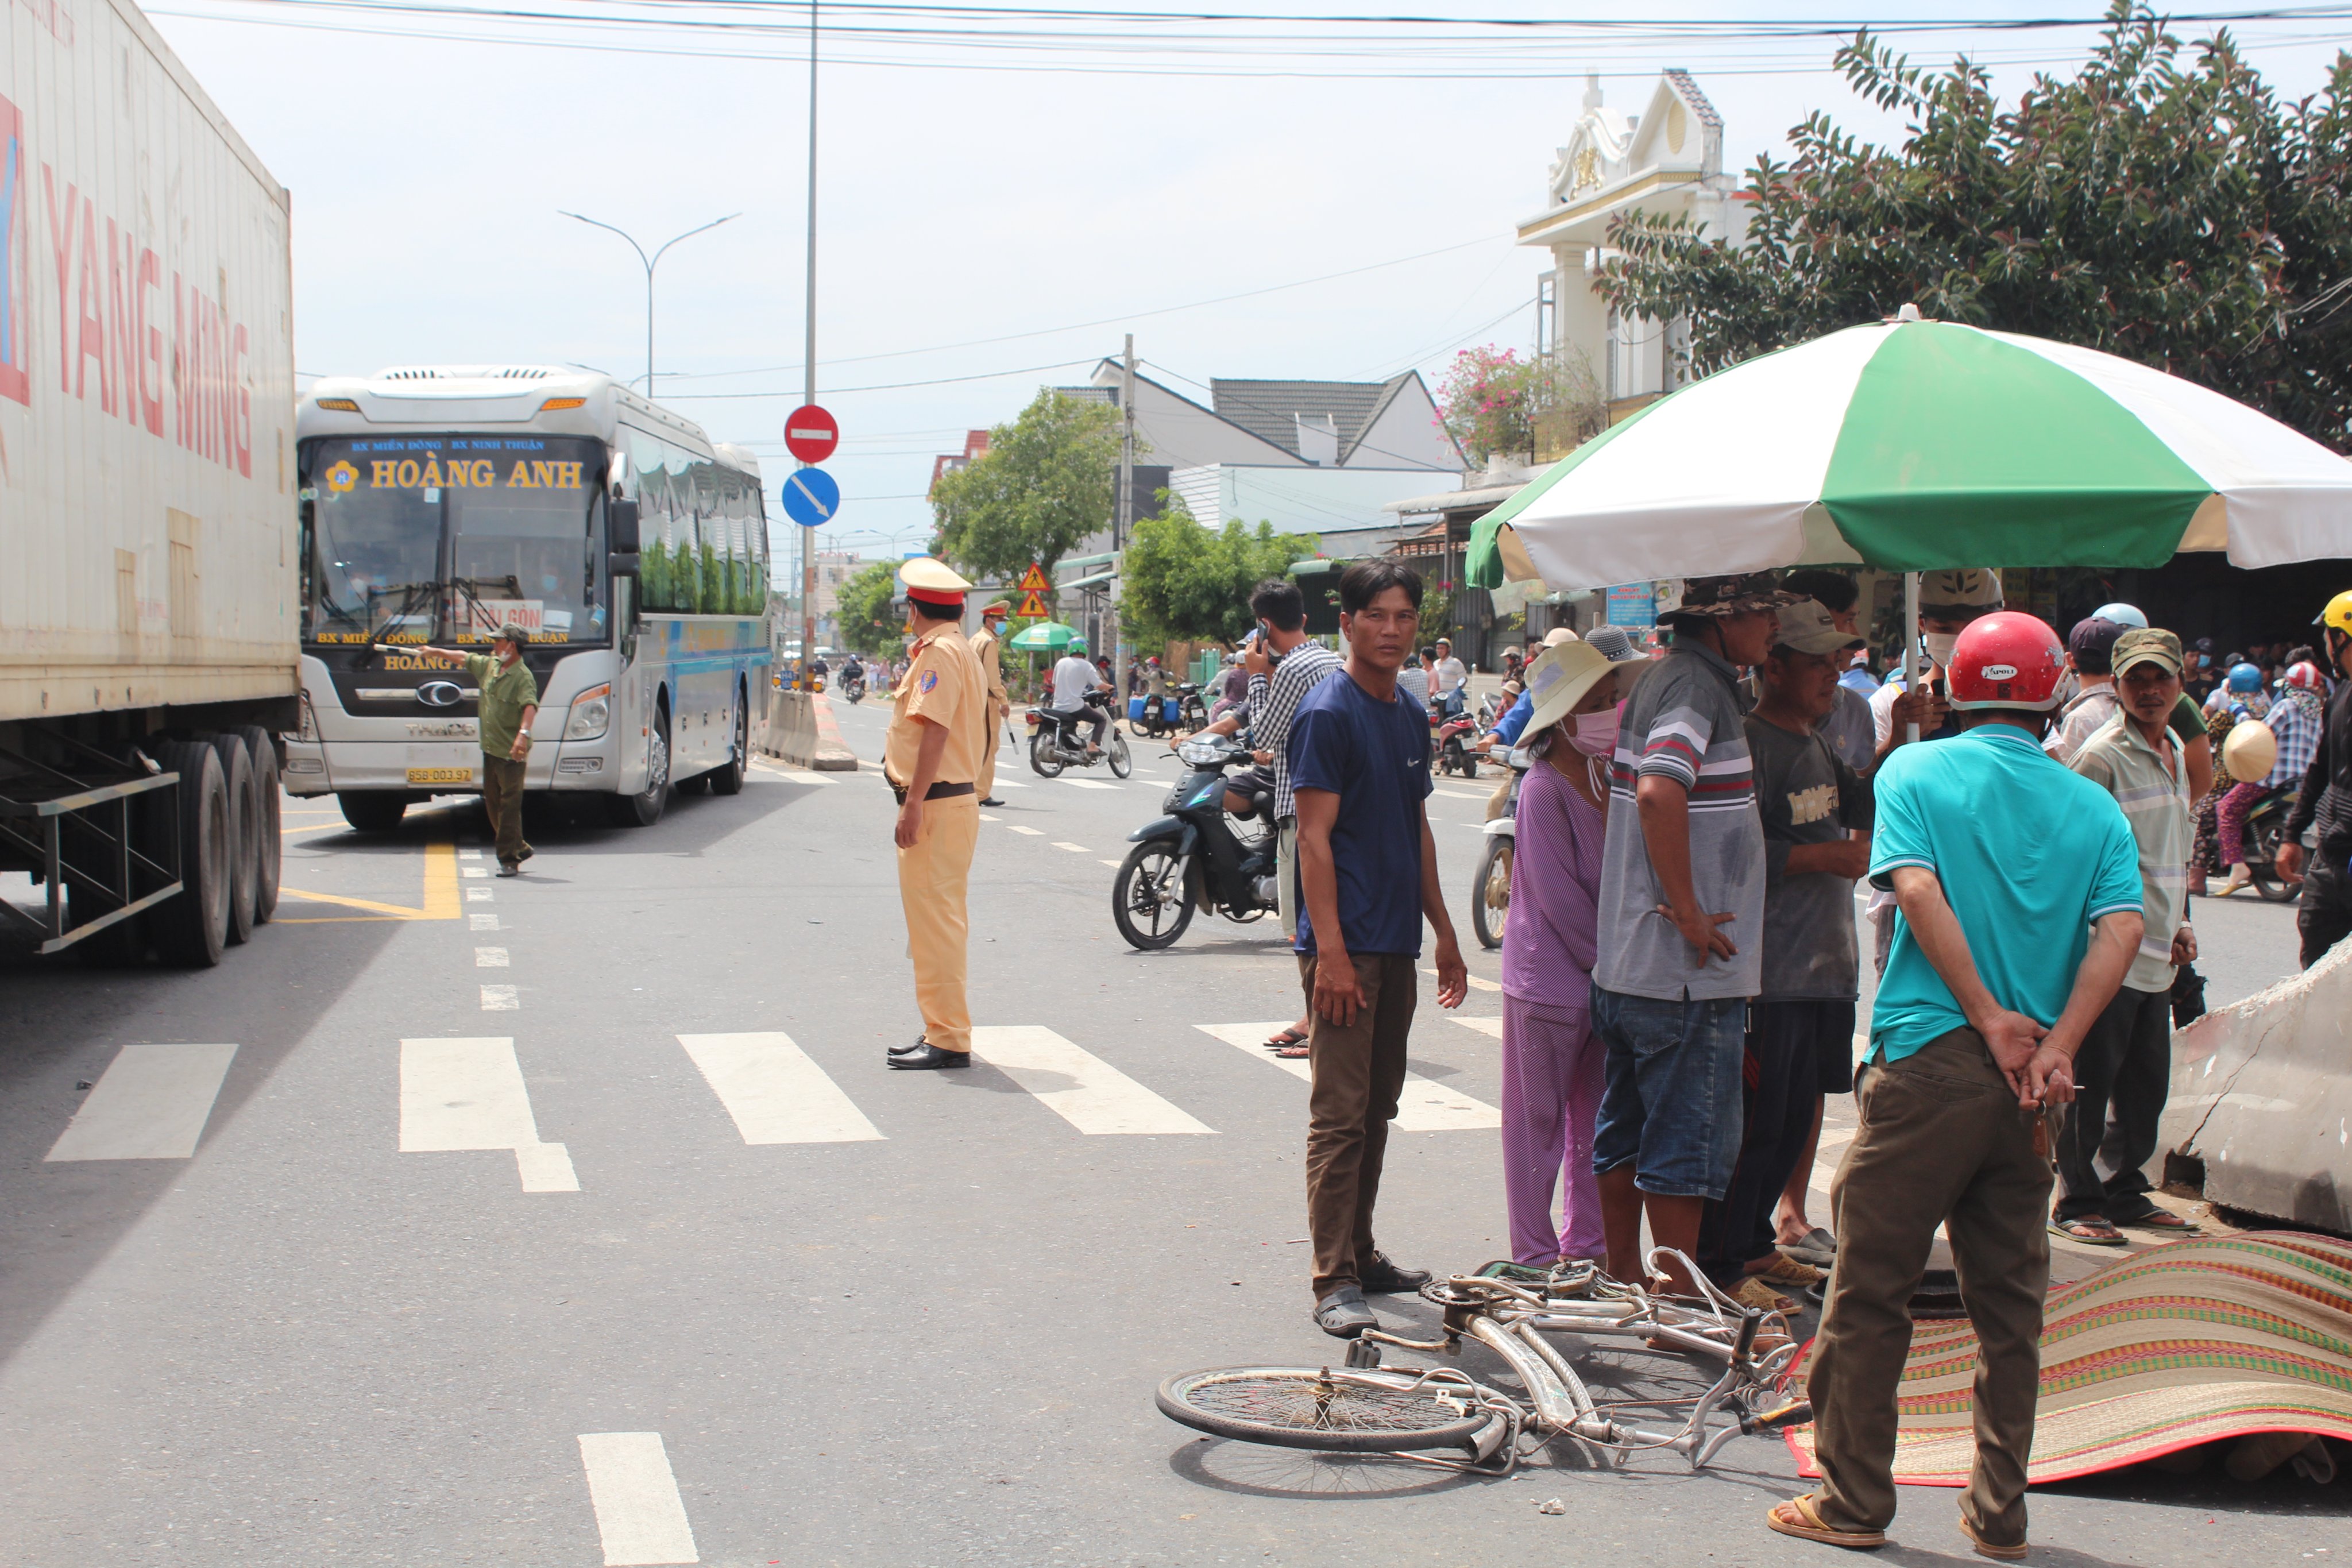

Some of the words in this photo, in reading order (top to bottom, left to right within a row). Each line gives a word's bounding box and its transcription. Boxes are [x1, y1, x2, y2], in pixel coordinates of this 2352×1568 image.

[42, 161, 164, 439] YANG
[173, 270, 251, 479] MING
[352, 442, 369, 451] BX
[451, 441, 468, 450] BX
[471, 441, 501, 450] NINH
[370, 450, 496, 488] HOÀNG
[505, 460, 584, 489] ANH
[476, 605, 501, 628] SÀI
[507, 604, 540, 628] GÒN
[317, 633, 338, 643] BX
[386, 631, 428, 644] ĐÔNG
[456, 634, 476, 644] BX
[1984, 667, 2014, 678] NAPOLI
[405, 724, 476, 736] THACO
